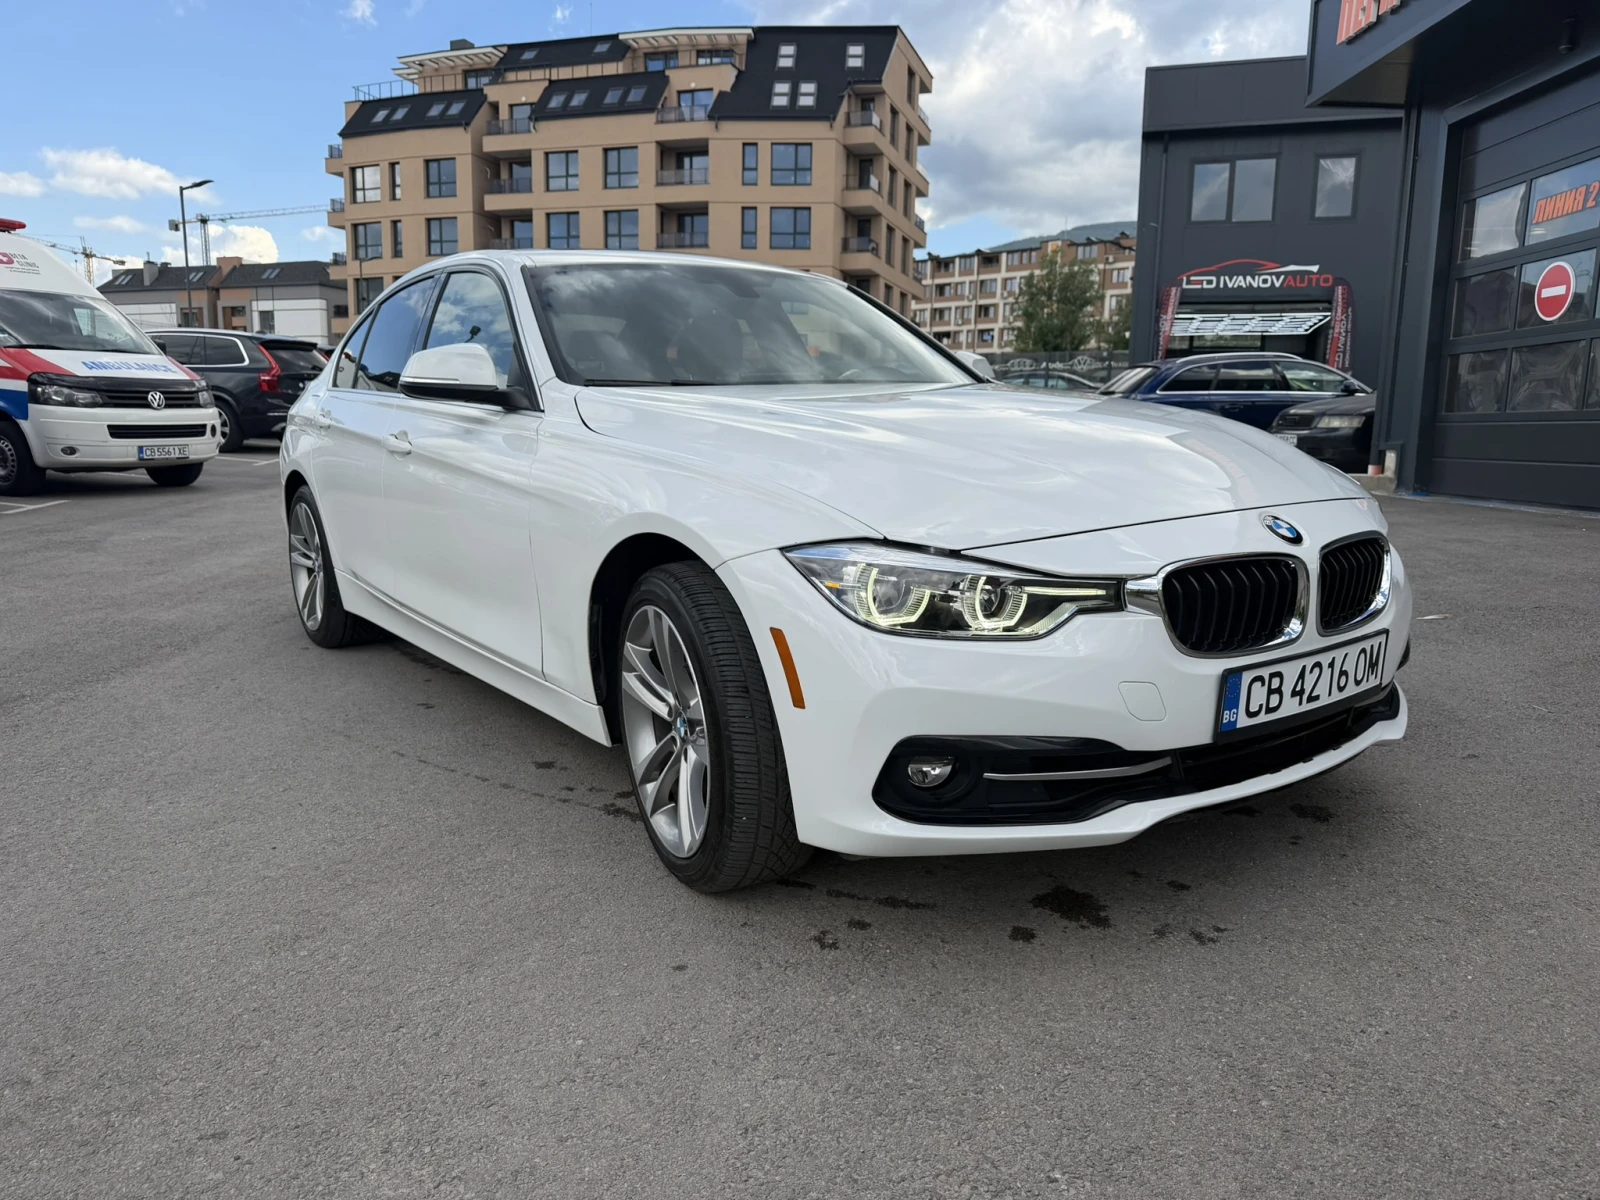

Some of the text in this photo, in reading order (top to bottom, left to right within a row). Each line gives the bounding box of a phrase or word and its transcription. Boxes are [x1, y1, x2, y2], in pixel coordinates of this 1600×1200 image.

[1532, 181, 1600, 225] ЛИНИЯ 2
[81, 361, 177, 374] AMBULANCE
[144, 447, 156, 457] CB
[157, 447, 176, 457] 5561
[177, 446, 188, 456] XE
[1244, 640, 1382, 719] CB 4216 OM
[1222, 708, 1237, 724] BG
